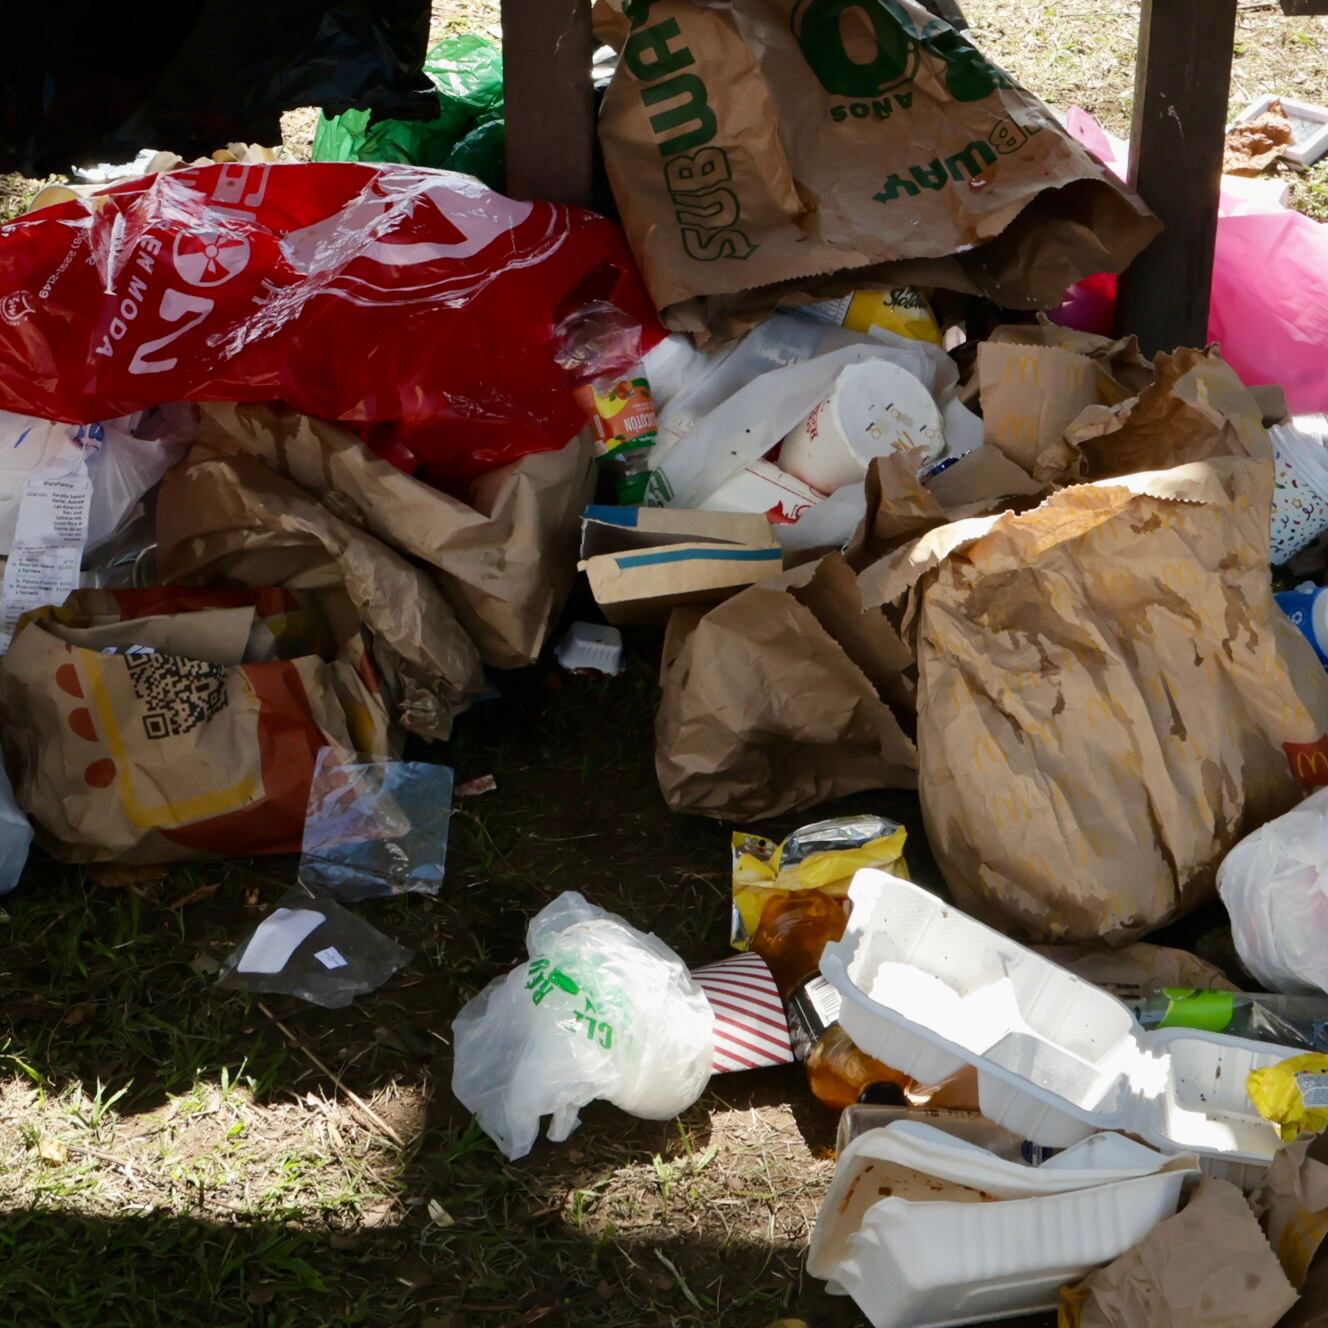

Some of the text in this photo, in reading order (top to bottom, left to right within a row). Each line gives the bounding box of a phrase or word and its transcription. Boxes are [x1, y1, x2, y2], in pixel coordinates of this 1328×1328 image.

[830, 92, 914, 124] AÑOS
[96, 235, 163, 357] EN MODA
